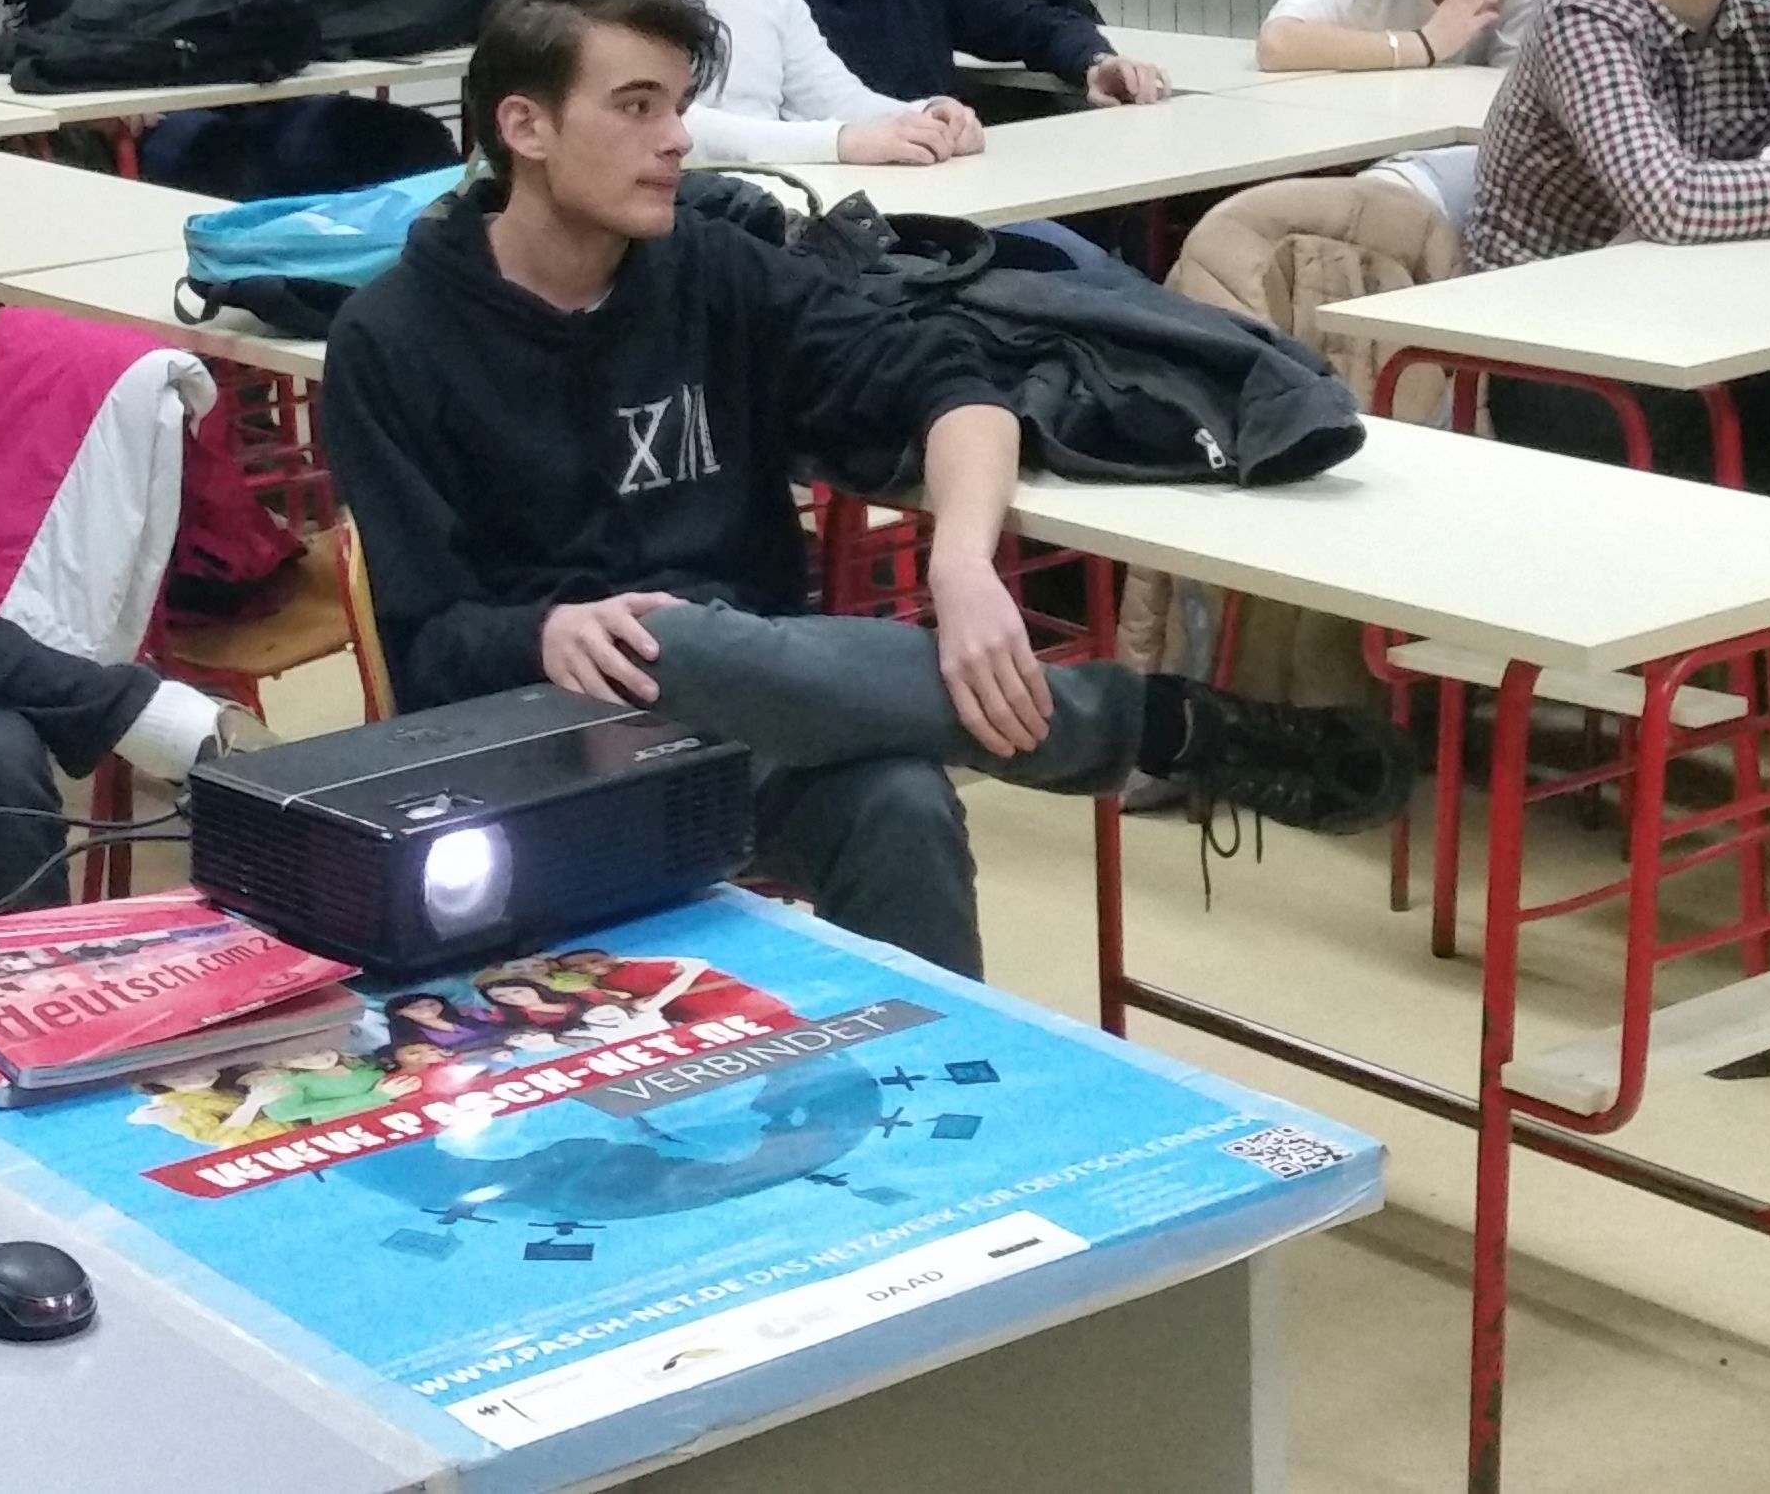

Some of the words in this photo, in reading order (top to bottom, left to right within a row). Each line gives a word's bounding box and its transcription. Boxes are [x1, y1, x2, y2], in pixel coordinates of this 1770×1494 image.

[248, 935, 279, 952] 2
[866, 1269, 945, 1302] DAAD
[412, 1279, 744, 1396] WWW.PASCH-NET.DE
[745, 1259, 809, 1286] DAS
